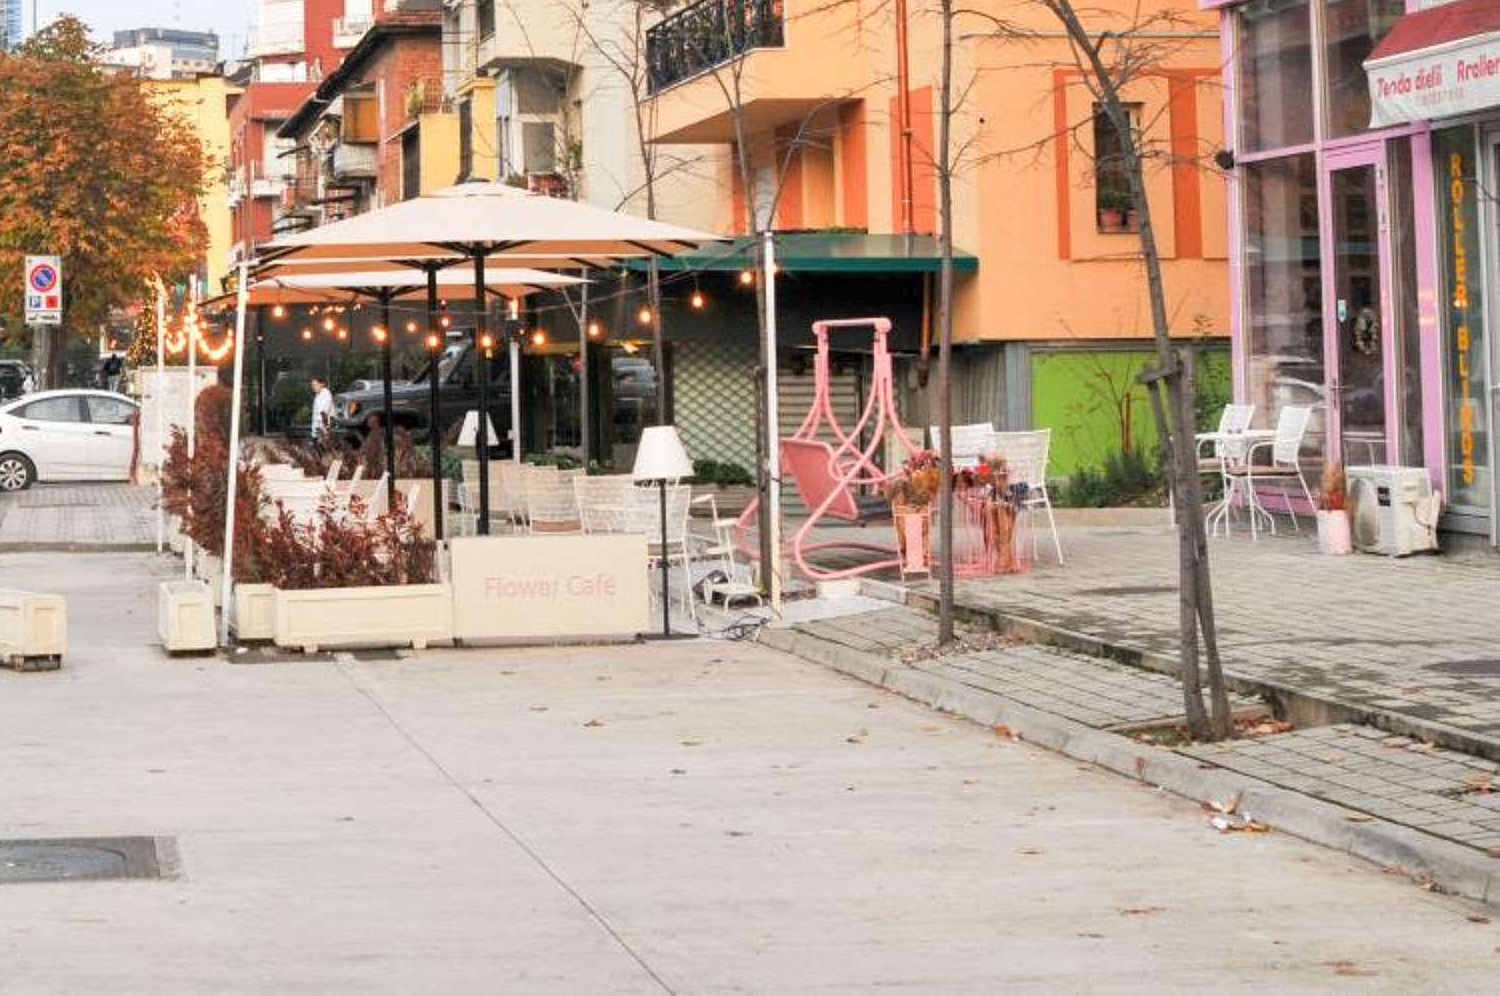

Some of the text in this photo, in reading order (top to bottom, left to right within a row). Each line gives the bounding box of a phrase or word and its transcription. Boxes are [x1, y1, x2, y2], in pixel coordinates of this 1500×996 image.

[1377, 71, 1412, 99] Tenda
[1451, 154, 1467, 308] ROLLER
[484, 573, 616, 597] Flower Café
